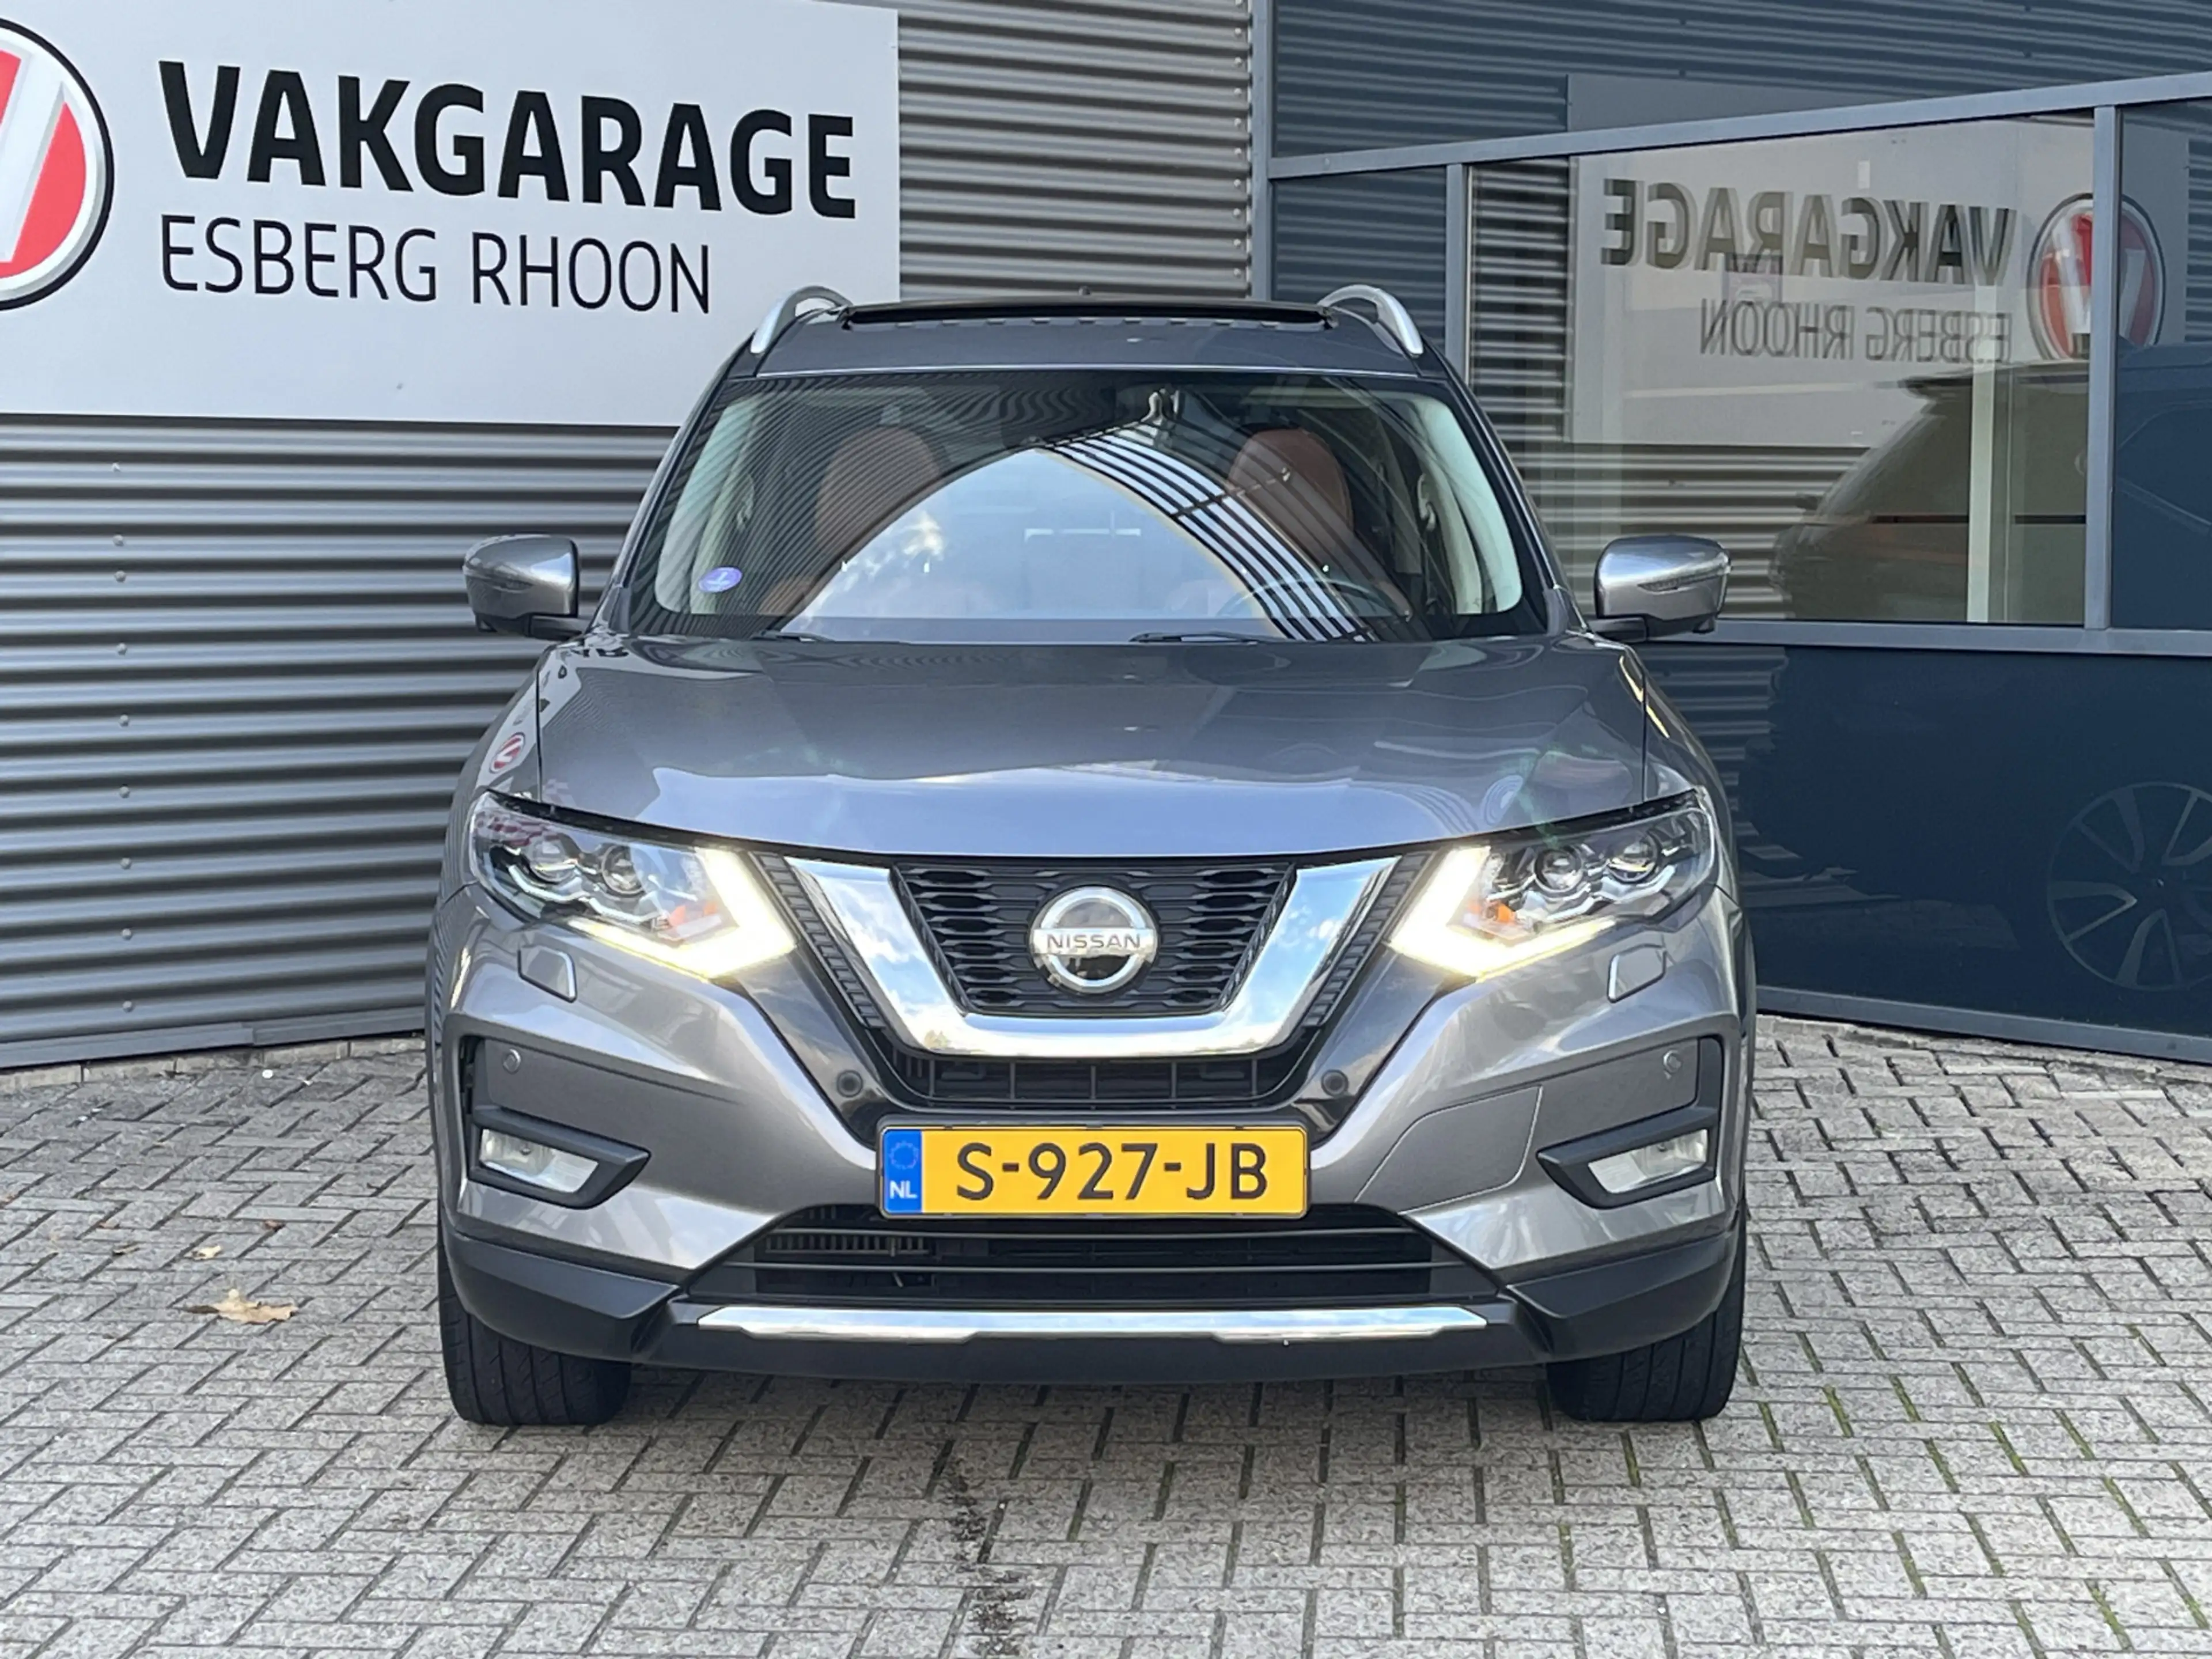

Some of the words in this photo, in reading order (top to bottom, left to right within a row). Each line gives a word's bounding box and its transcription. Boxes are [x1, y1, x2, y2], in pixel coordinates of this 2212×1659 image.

[159, 60, 855, 219] VAKGARAGE
[161, 214, 436, 302] ESBERG
[472, 232, 709, 315] RHOON
[1047, 934, 1141, 949] NISSAN
[890, 1180, 917, 1199] NL
[956, 1142, 1267, 1201] S-927-JB
